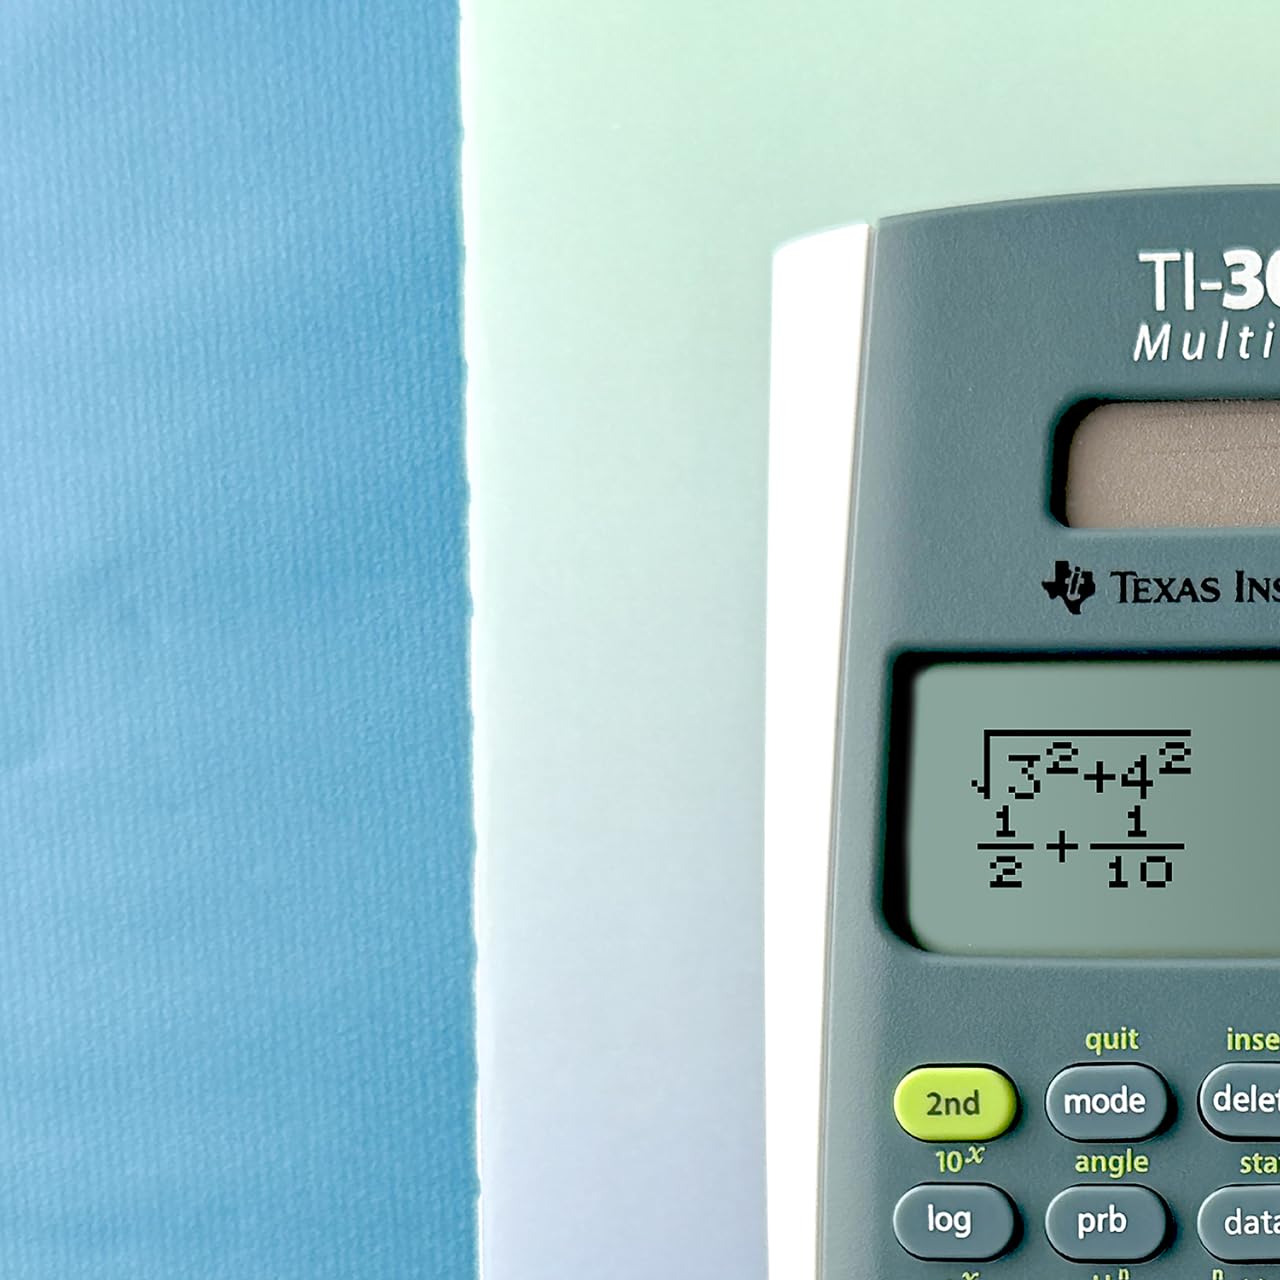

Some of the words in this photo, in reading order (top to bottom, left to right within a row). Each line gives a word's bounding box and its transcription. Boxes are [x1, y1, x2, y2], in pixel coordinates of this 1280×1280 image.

[1109, 570, 1221, 605] TEXAS
[995, 804, 1016, 838] 1
[1127, 804, 1148, 838] 1
[989, 855, 1023, 889] 2
[1108, 855, 1173, 889] 10
[1085, 1027, 1139, 1056] quit
[926, 1088, 981, 1116] 2nd
[1064, 1085, 1146, 1114] mode
[1075, 1149, 1149, 1179] angle
[927, 1203, 971, 1238] log
[1078, 1204, 1127, 1240] prb
